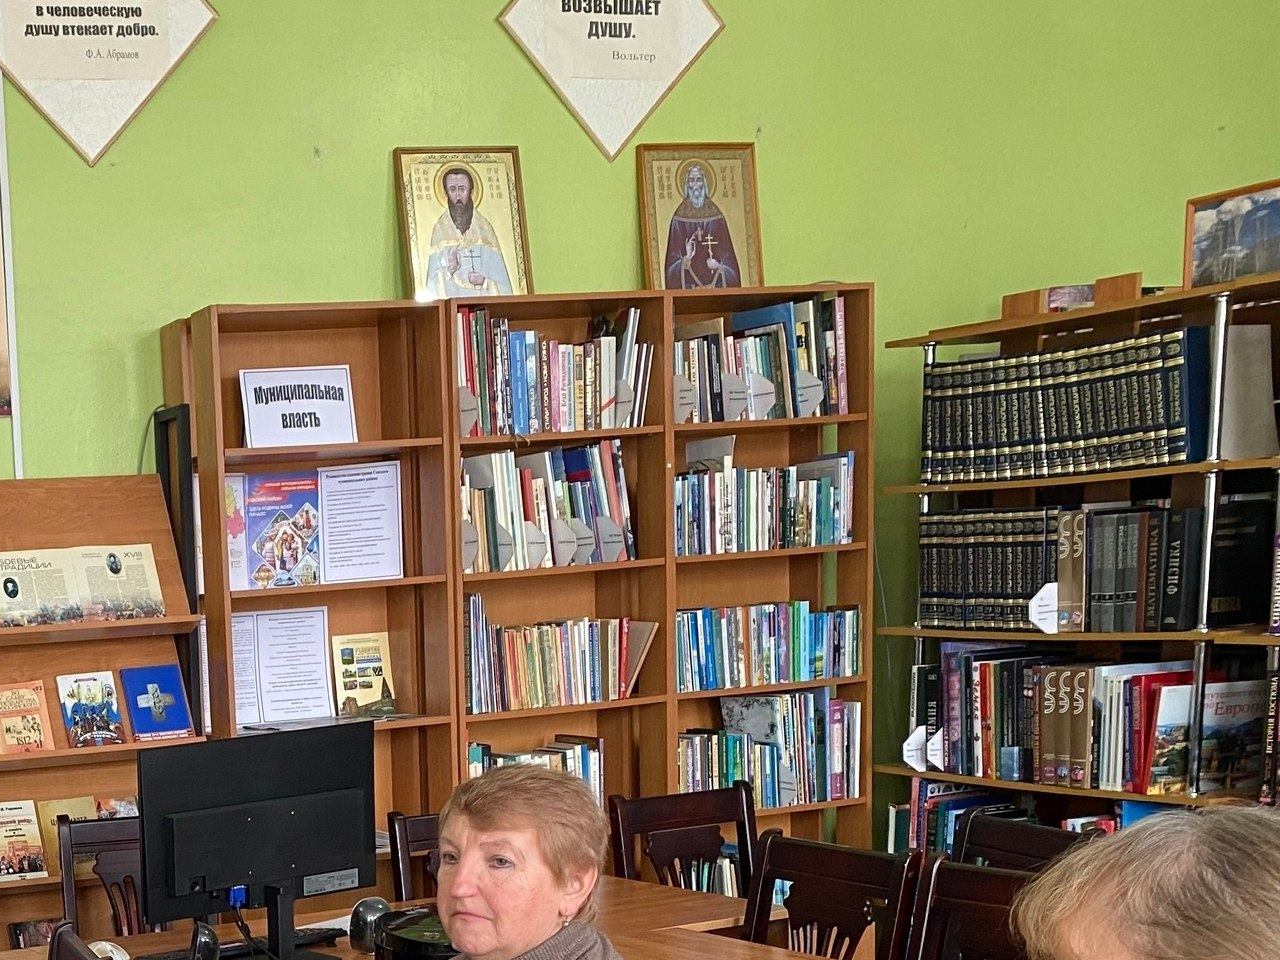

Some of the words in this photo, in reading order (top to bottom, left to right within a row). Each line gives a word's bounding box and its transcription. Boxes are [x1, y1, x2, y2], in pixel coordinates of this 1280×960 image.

[36, 6, 44, 17] в
[47, 5, 142, 18] человеческую
[561, 0, 661, 16] ВОЗВЫШАЕТ
[24, 24, 60, 37] душу
[63, 24, 114, 36] втекает
[116, 23, 159, 37] добро.
[587, 20, 637, 40] ДУШУ.
[85, 48, 104, 60] Ф.А.
[106, 48, 140, 61] Абрамов
[612, 50, 656, 63] Вольтер
[253, 385, 345, 406] Муниципальная
[280, 410, 322, 430] власть
[0, 562, 52, 571] ТРАДИЦИИ
[1147, 529, 1160, 618] МАТЕМАТИКА
[1168, 540, 1181, 595] ФИЗИКА
[1269, 676, 1279, 716] КОСТЮМА
[16, 736, 32, 745] 1812
[1265, 718, 1275, 754] ИСТОРИЯ
